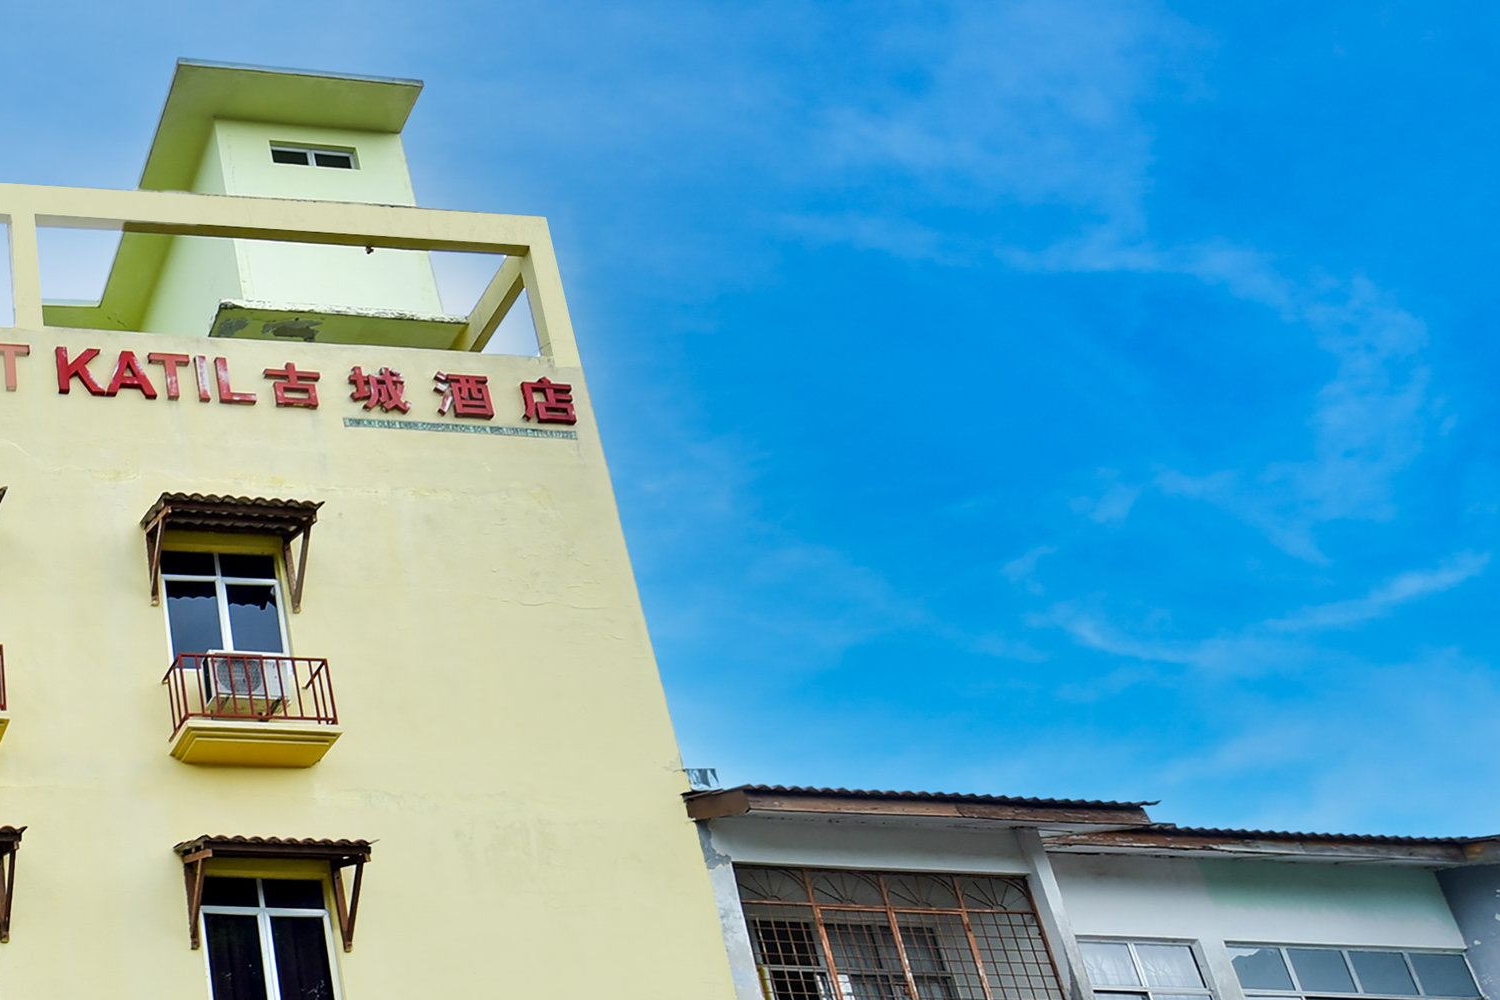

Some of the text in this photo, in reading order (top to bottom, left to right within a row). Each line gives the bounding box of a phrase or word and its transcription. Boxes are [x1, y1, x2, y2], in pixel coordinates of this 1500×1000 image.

[55, 346, 257, 405] KATIL
[263, 362, 578, 426] 古城酒店
